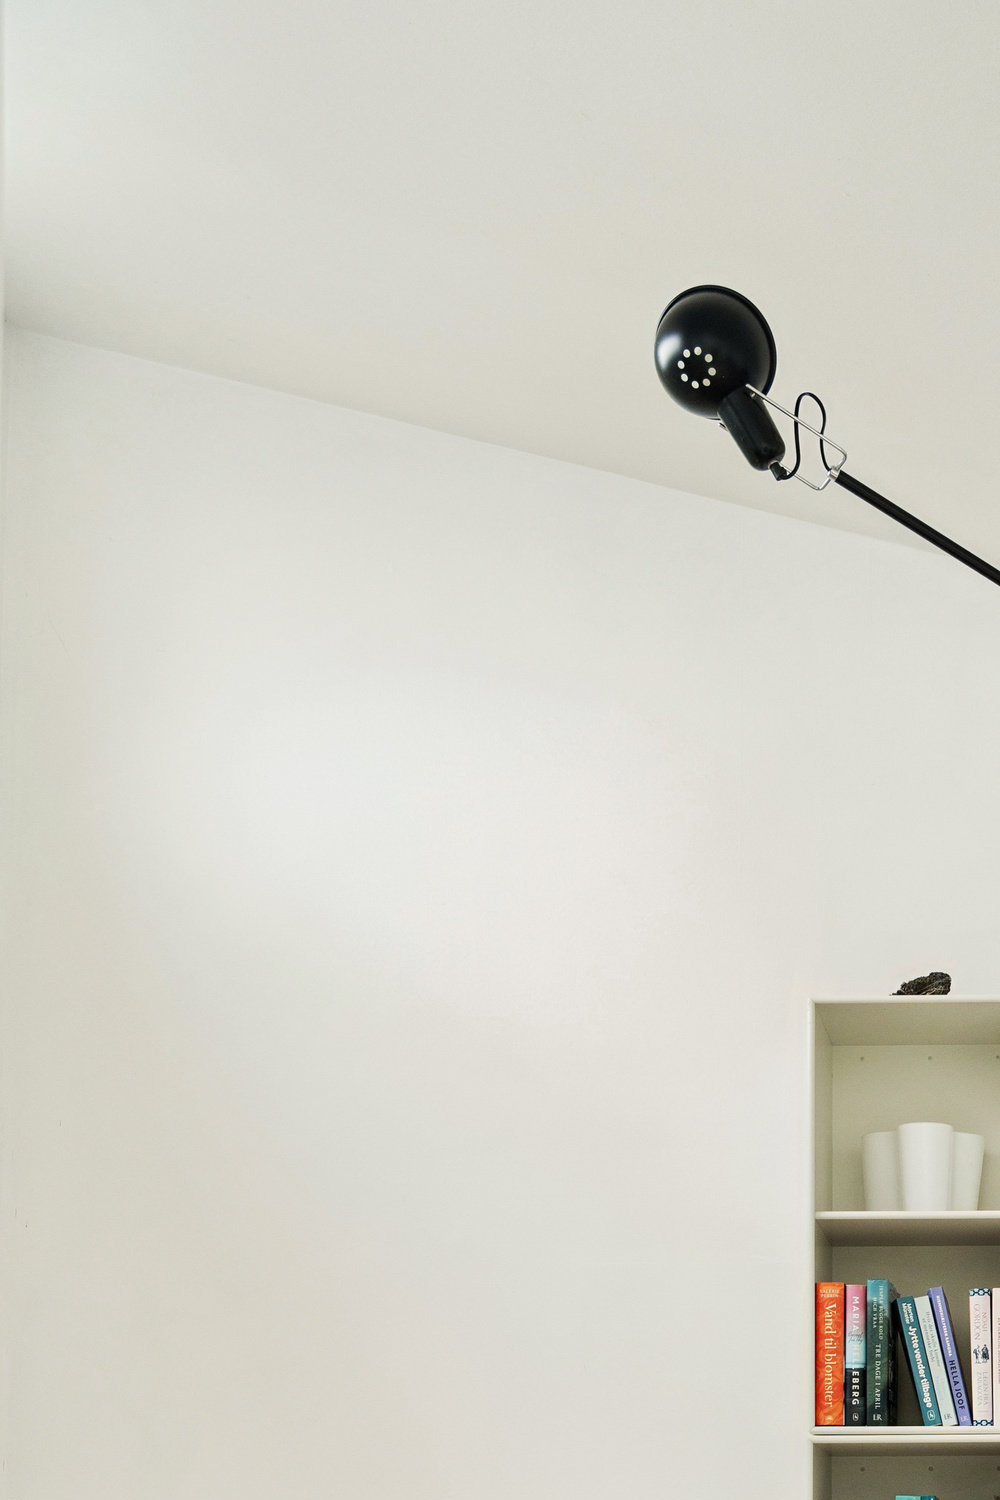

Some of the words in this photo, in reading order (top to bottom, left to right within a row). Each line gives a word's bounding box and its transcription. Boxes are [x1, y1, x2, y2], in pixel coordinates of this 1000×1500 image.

[824, 1303, 837, 1334] Vand
[824, 1338, 837, 1349] til
[824, 1354, 837, 1407] blomster
[949, 1360, 960, 1386] HELLA
[955, 1388, 965, 1410] JOOF
